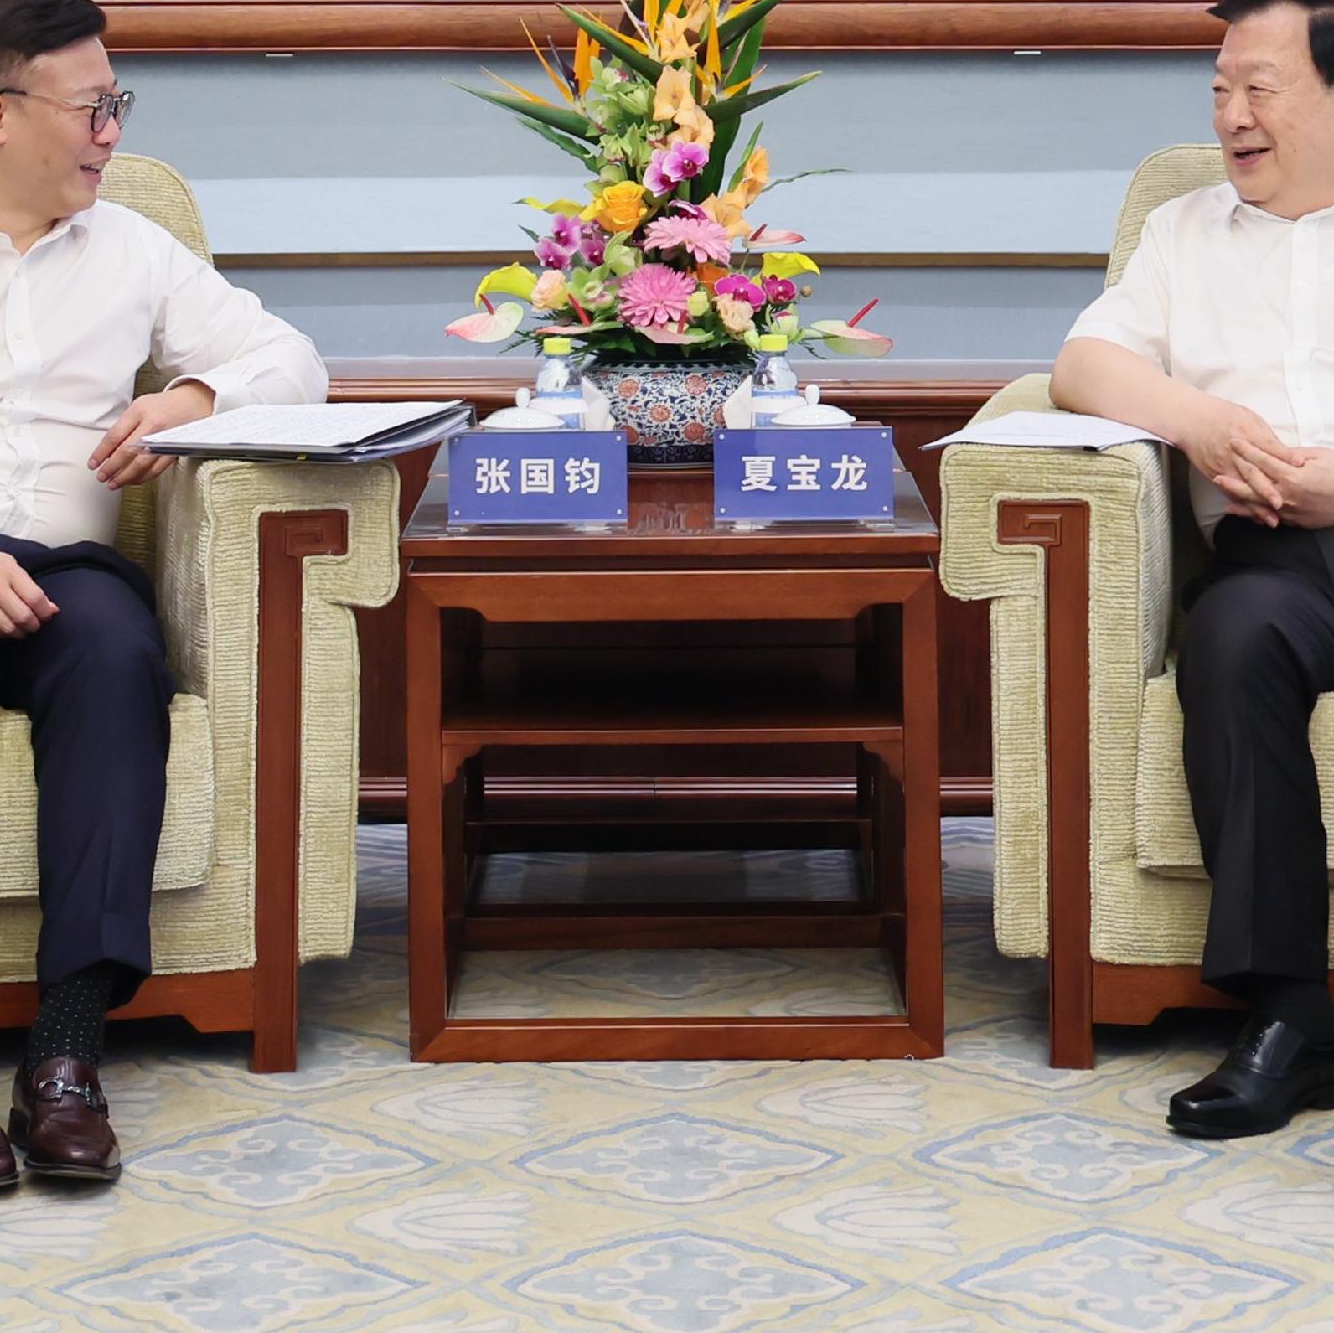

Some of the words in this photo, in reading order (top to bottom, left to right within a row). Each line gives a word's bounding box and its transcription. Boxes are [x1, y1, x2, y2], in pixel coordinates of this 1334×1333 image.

[475, 457, 601, 495] 张国钧
[741, 454, 869, 493] 夏宝龙
